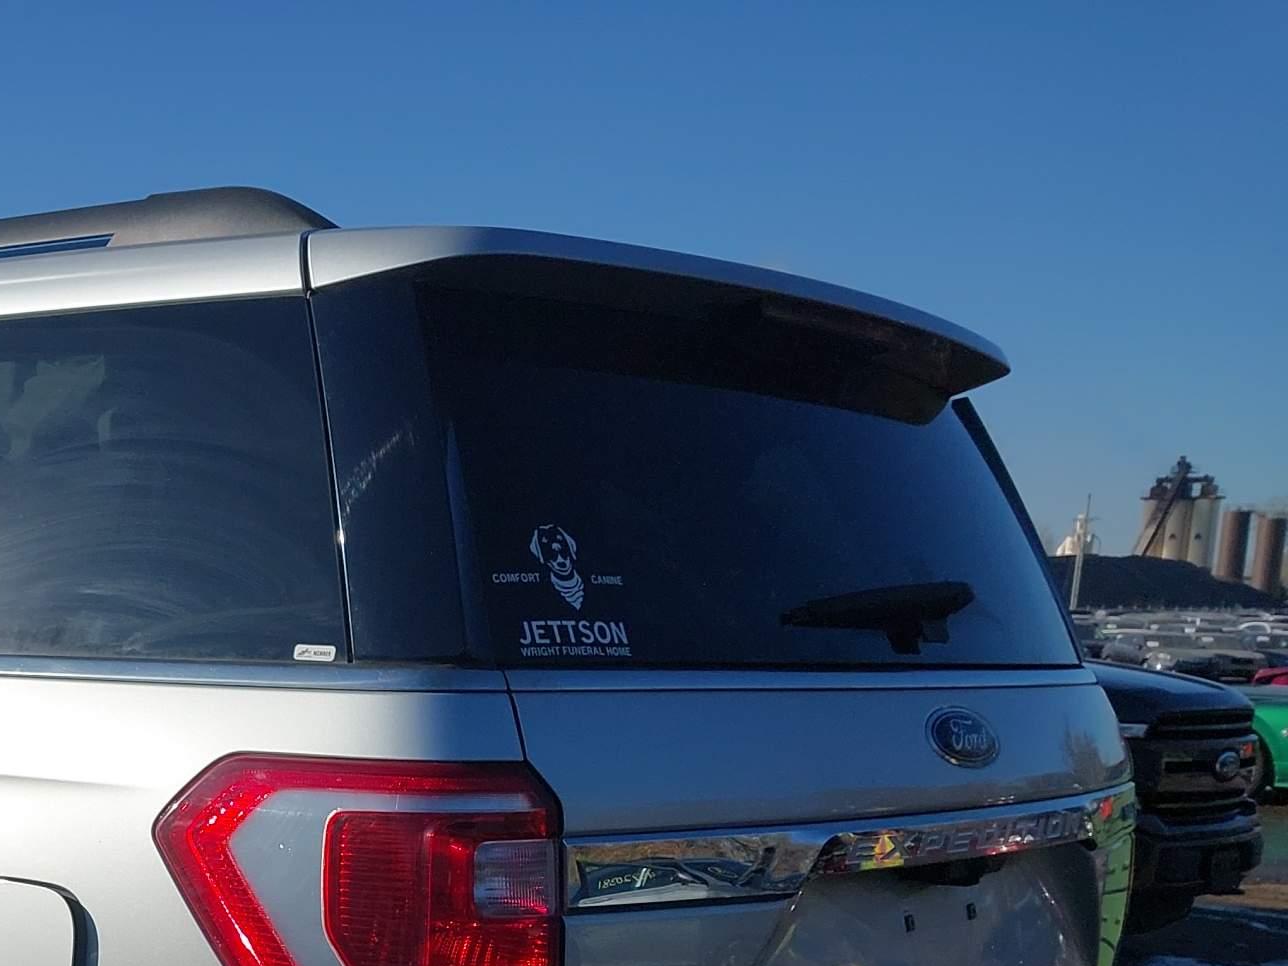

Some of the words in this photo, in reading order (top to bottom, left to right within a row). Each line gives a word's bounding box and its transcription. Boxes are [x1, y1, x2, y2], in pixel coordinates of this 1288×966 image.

[492, 573, 541, 583] COMFORT
[591, 575, 624, 586] CANINE
[520, 621, 629, 644] JETTSON
[521, 647, 560, 657] WRIGHT
[562, 646, 605, 657] FUNERAL
[606, 647, 633, 657] HOME
[848, 810, 1088, 860] EXPEDITION
